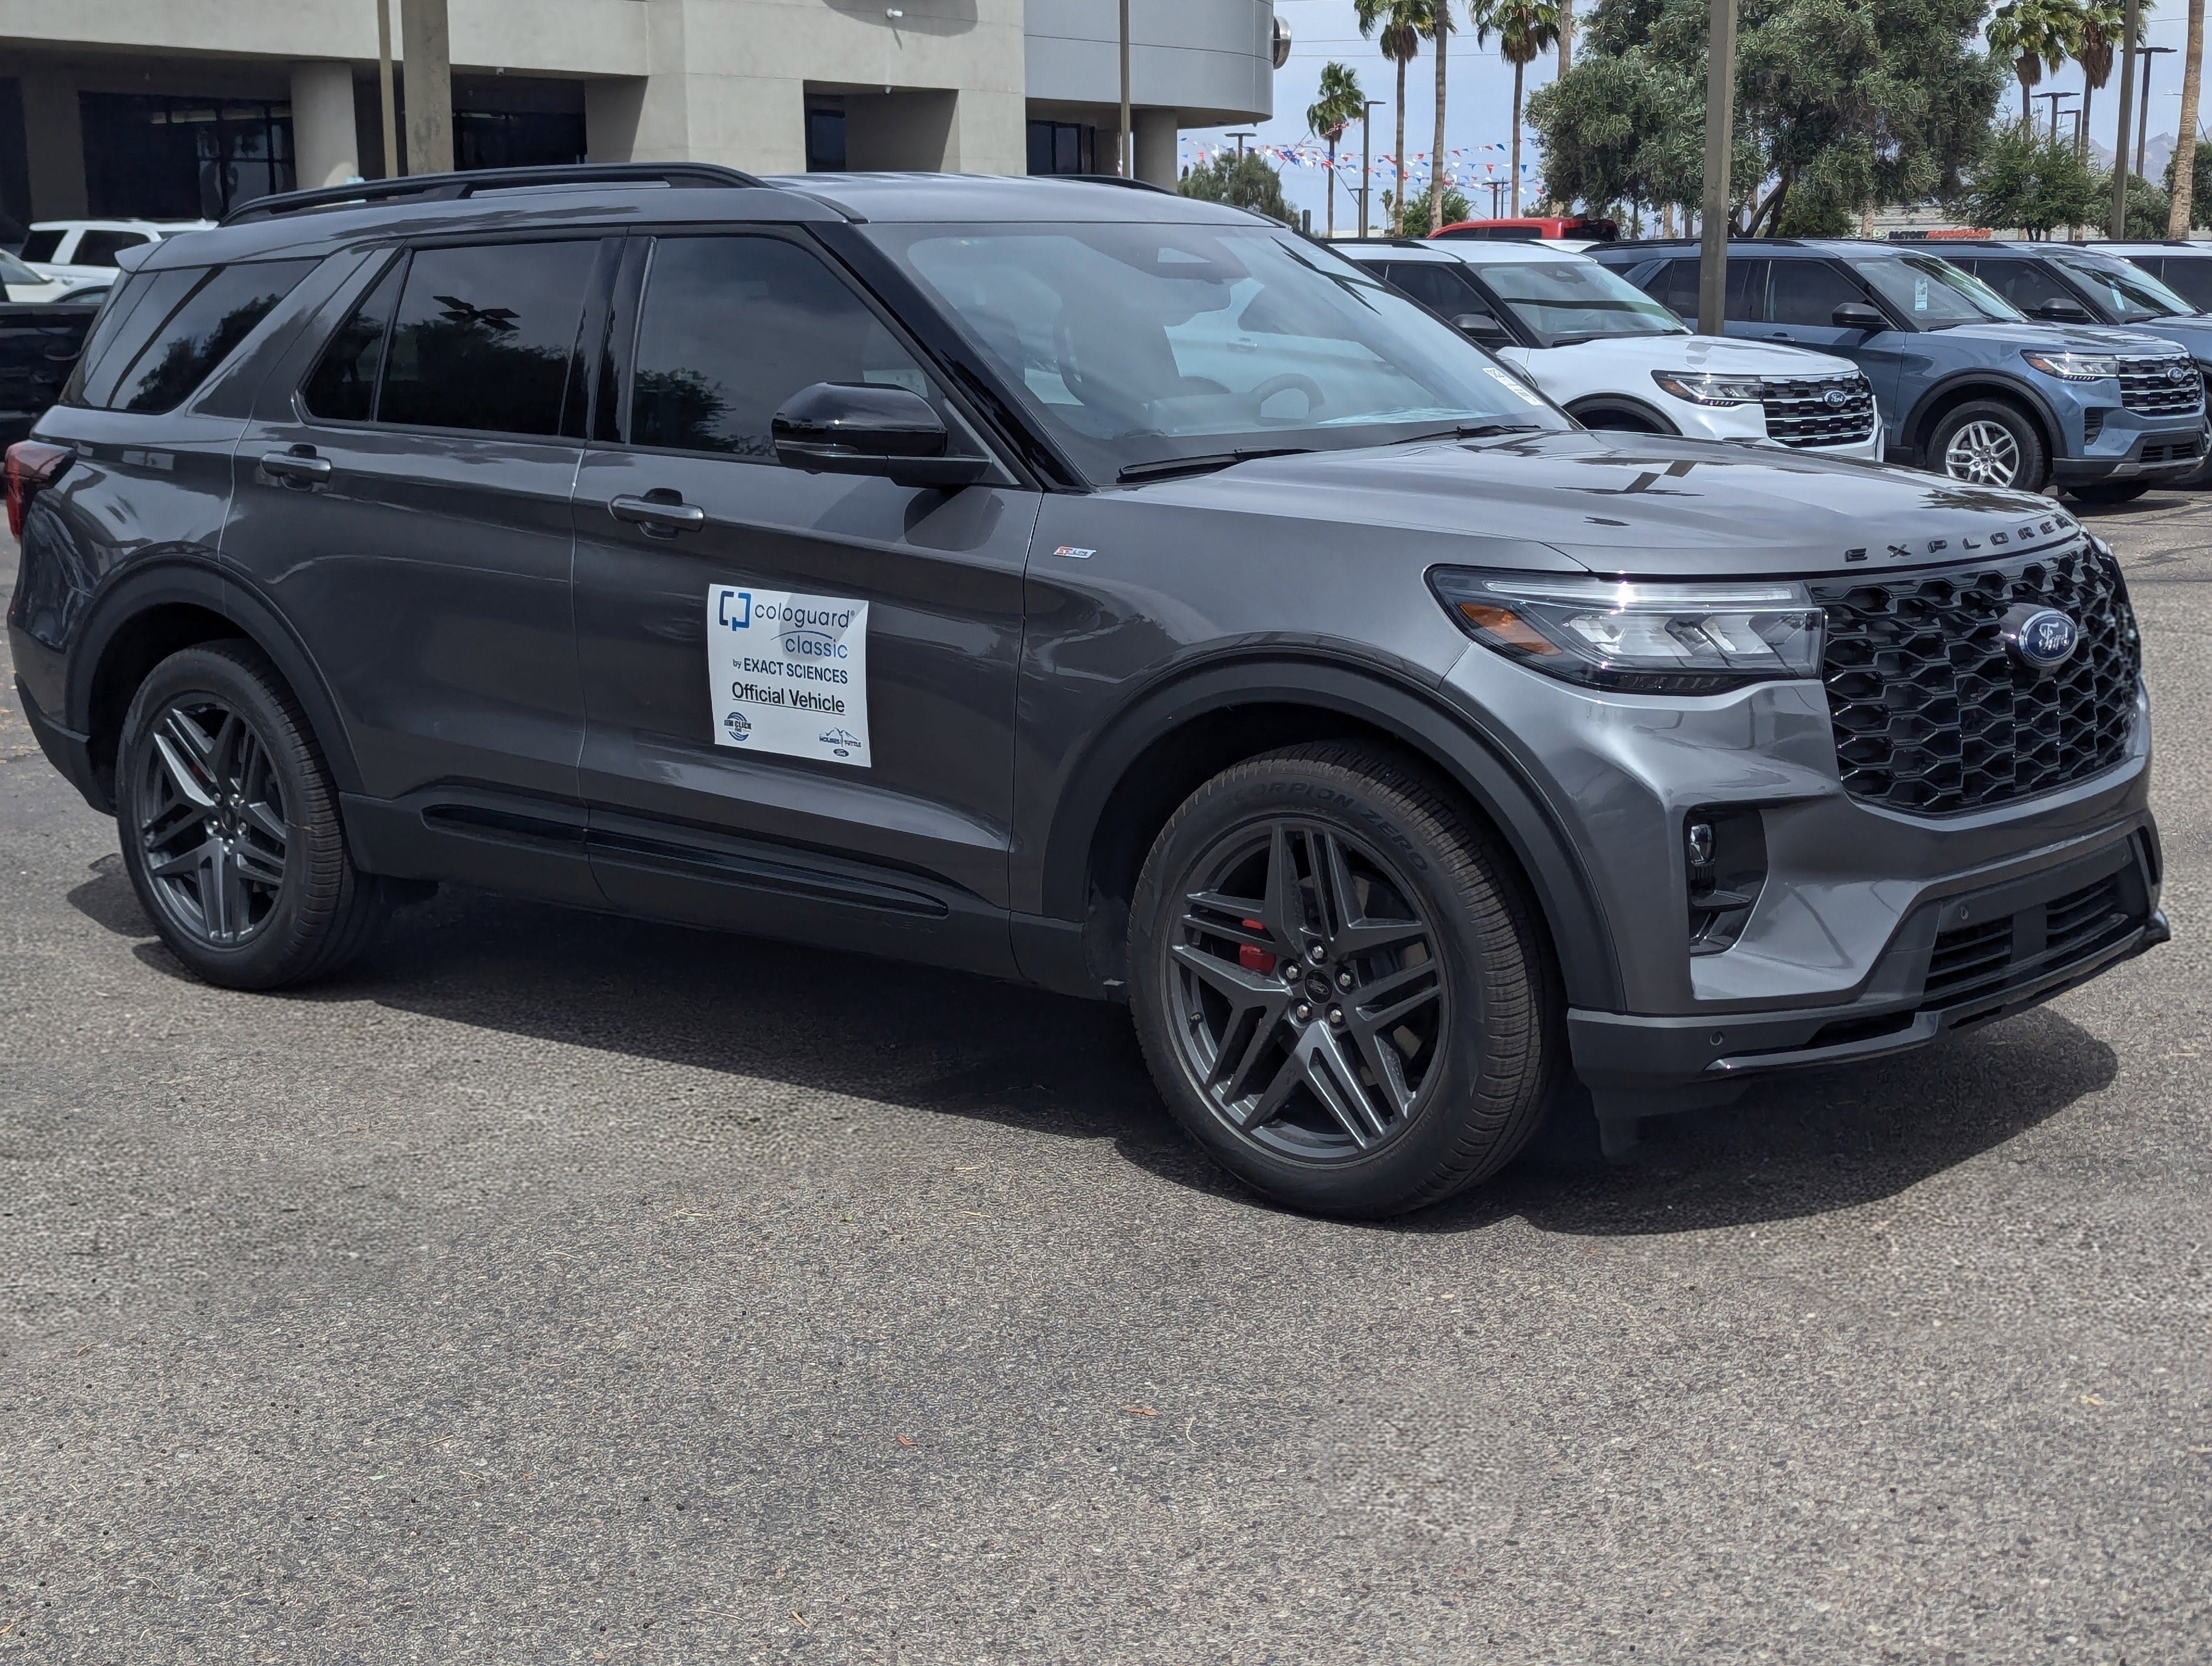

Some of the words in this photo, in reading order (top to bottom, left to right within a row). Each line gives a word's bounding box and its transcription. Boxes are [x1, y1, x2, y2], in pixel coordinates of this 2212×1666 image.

[755, 603, 850, 629] cologuard
[786, 635, 848, 659] classic
[732, 658, 742, 669] by
[744, 658, 784, 676] EXACT
[786, 663, 848, 684] SCIENCES
[732, 681, 785, 705] Official
[789, 689, 845, 713] Vehicle
[1360, 809, 1429, 871] ZERO
